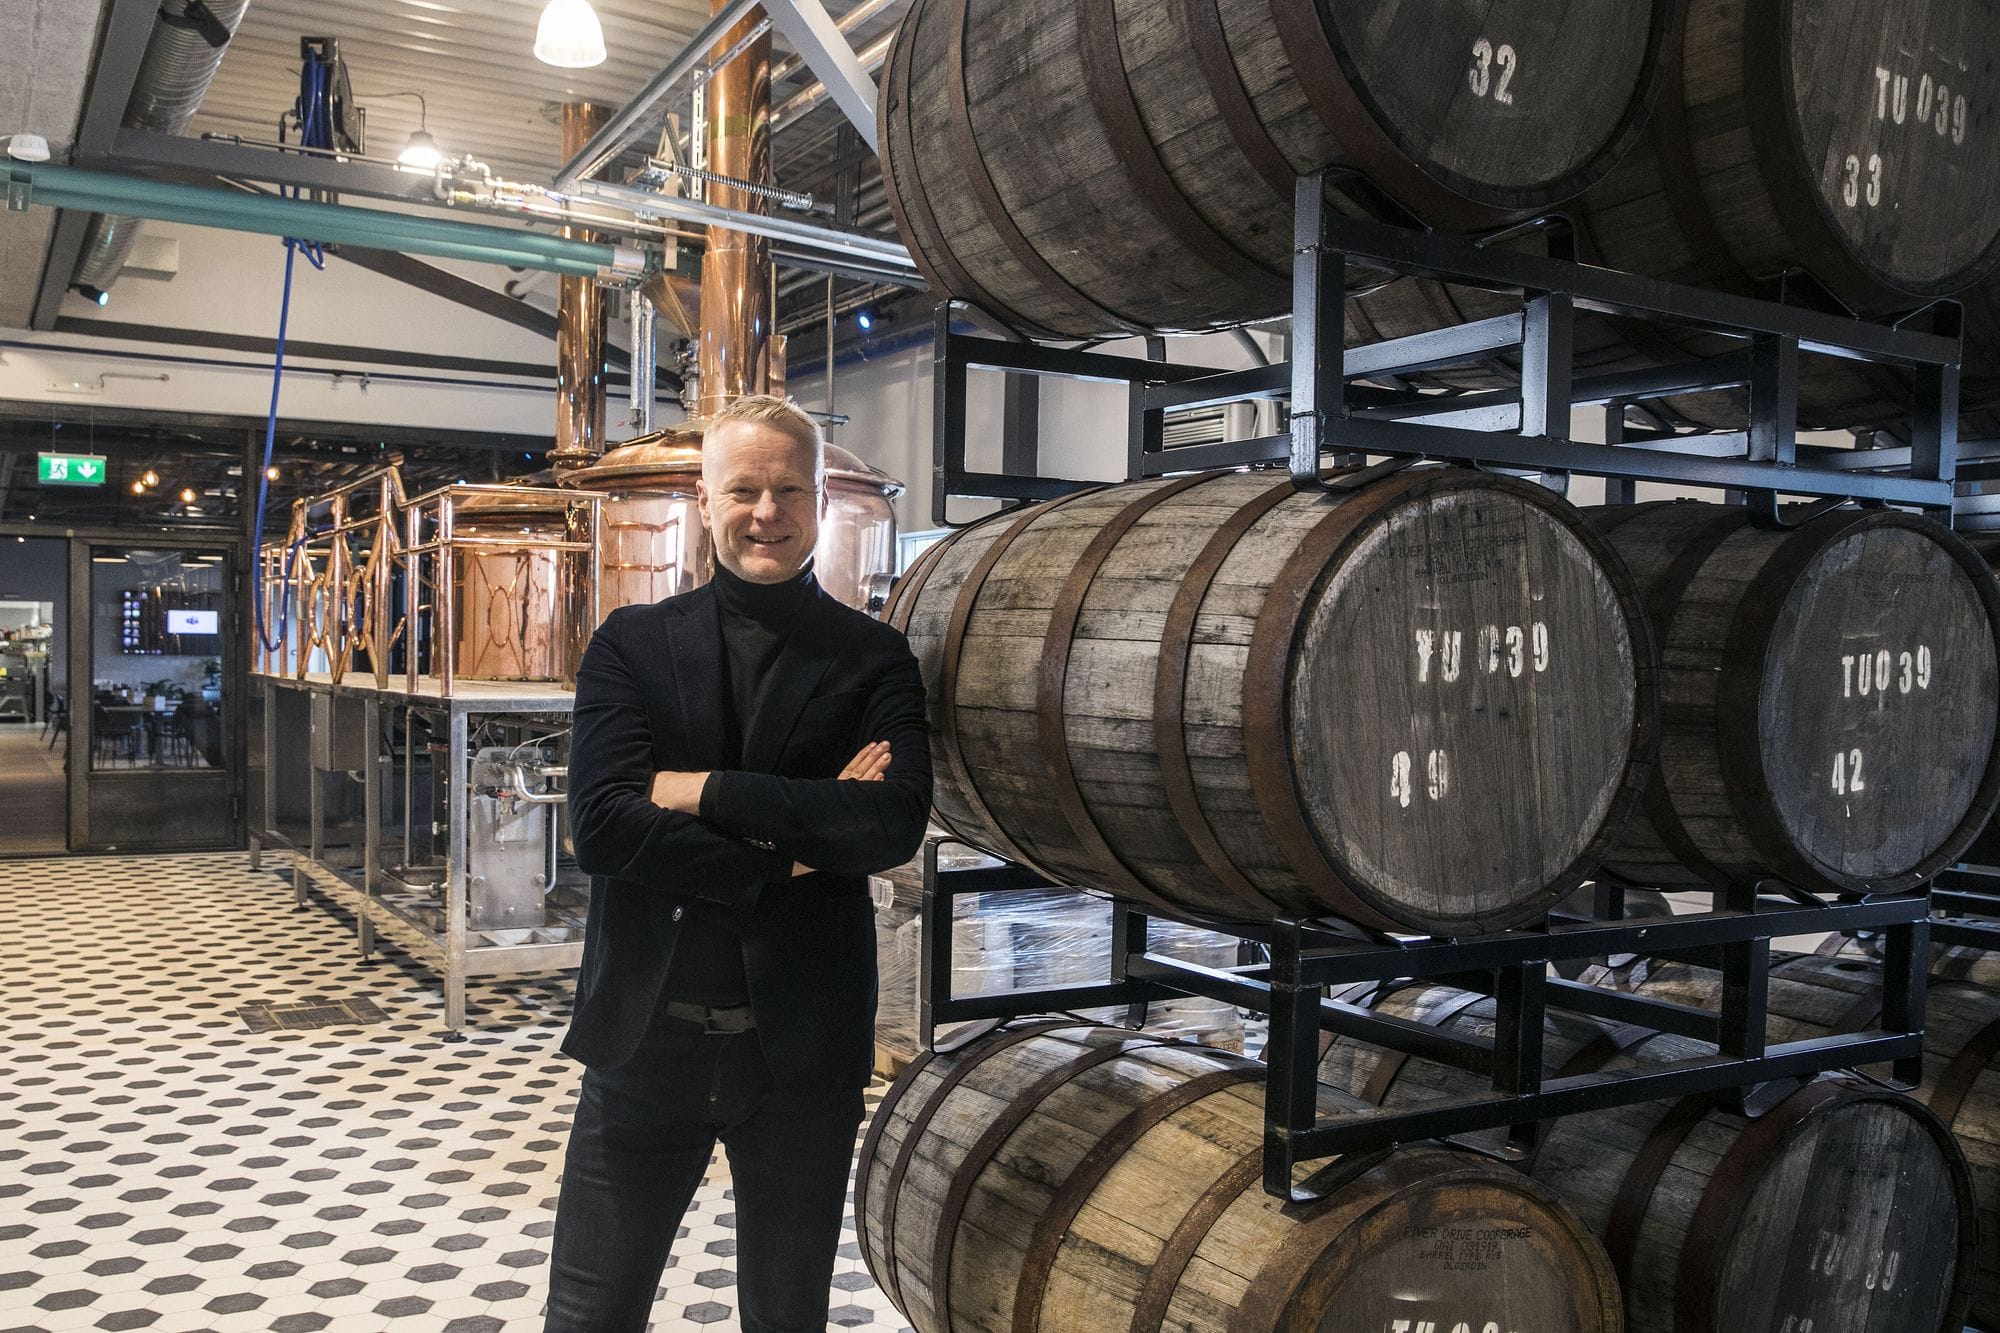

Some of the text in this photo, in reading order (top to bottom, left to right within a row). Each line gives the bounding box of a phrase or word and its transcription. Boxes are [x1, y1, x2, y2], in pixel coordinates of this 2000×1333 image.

[1469, 38, 1516, 105] 32
[1875, 67, 1907, 124] TU
[1843, 154, 1882, 207] 33
[1832, 748, 1864, 795] 42
[1441, 1229, 1473, 1241] DRIVE
[1475, 1226, 1533, 1241] COOPERAGE
